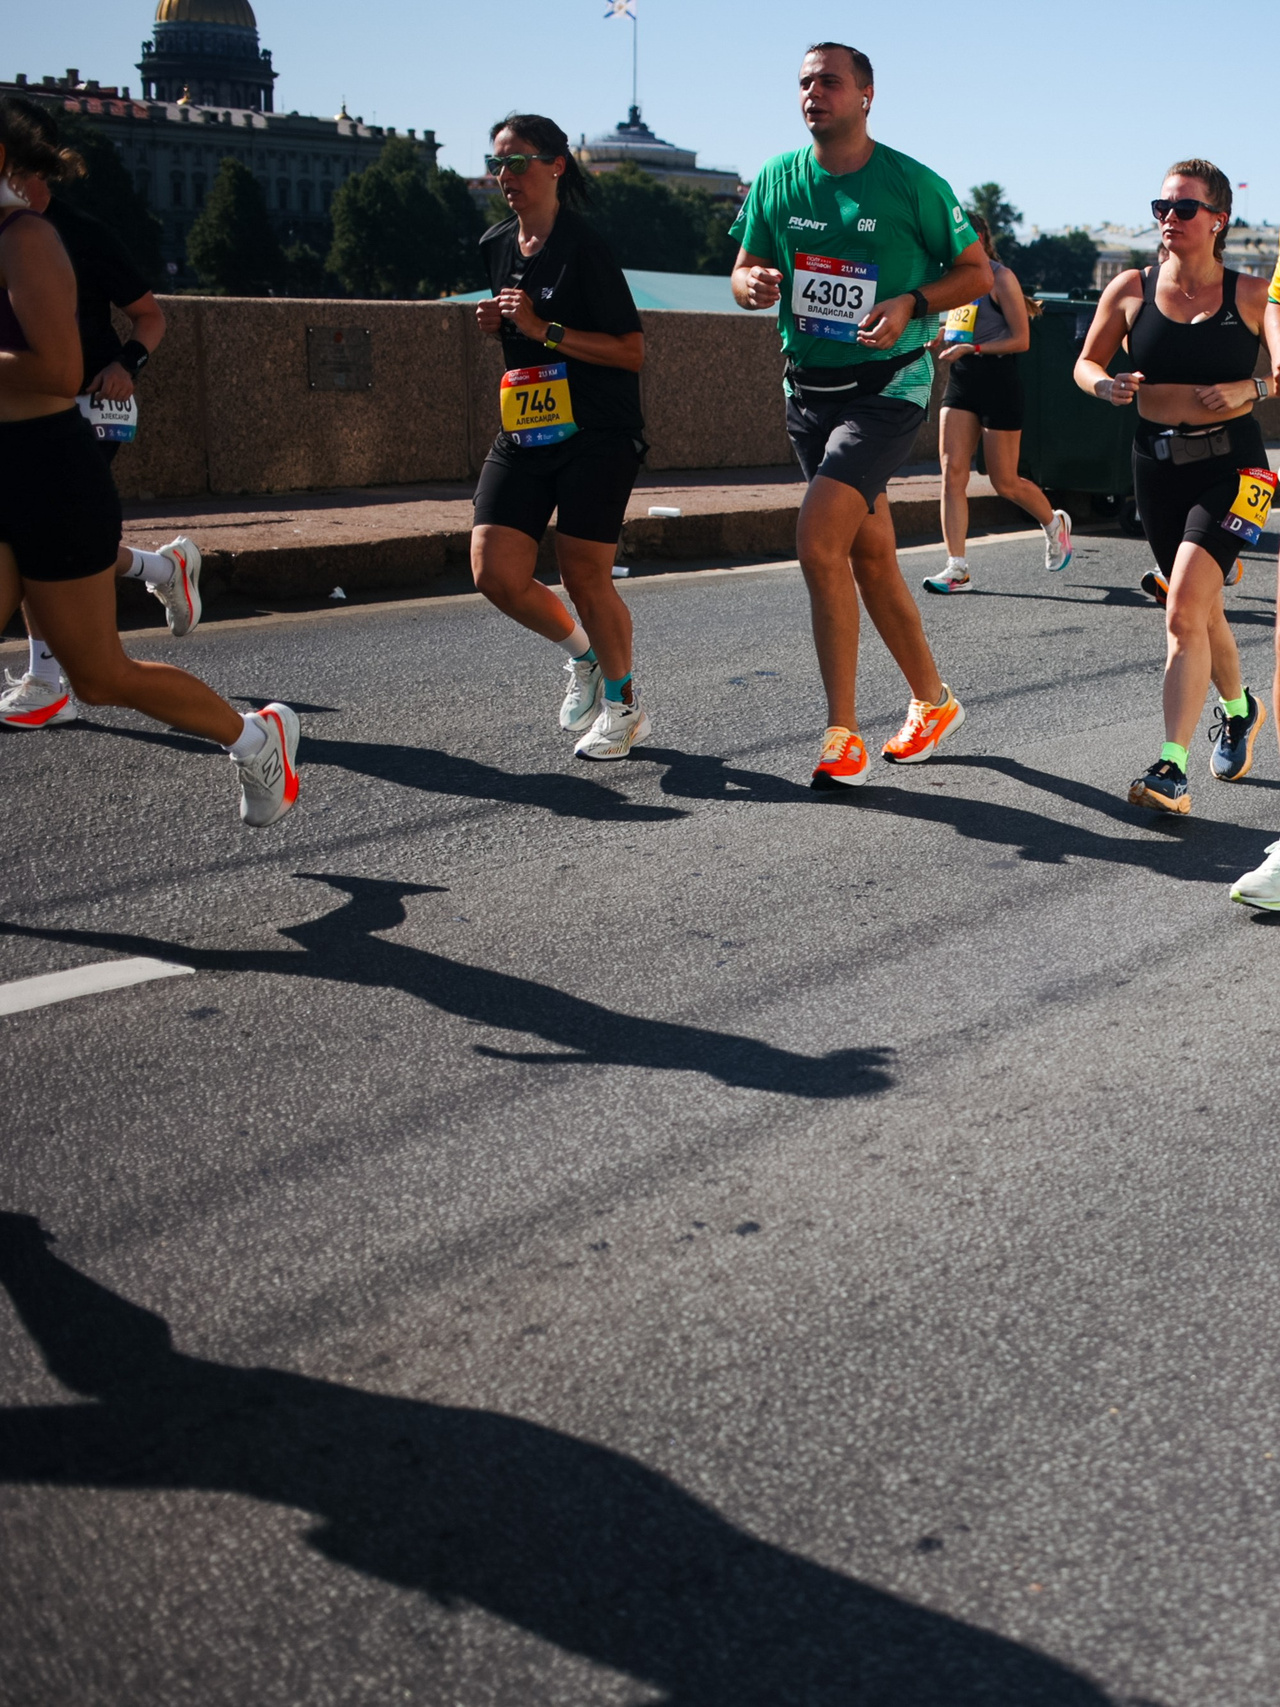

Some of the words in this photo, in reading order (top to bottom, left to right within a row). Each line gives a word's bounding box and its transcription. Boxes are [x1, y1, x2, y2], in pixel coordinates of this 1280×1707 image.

[788, 216, 828, 231] RUNIT
[802, 278, 864, 310] 4303
[807, 304, 855, 319] ВЛАДИСЛАВ
[798, 317, 807, 331] E
[515, 387, 557, 416] 746
[516, 413, 561, 426] АЛЕКСАНДРА
[96, 426, 105, 438] D
[1229, 517, 1243, 531] D
